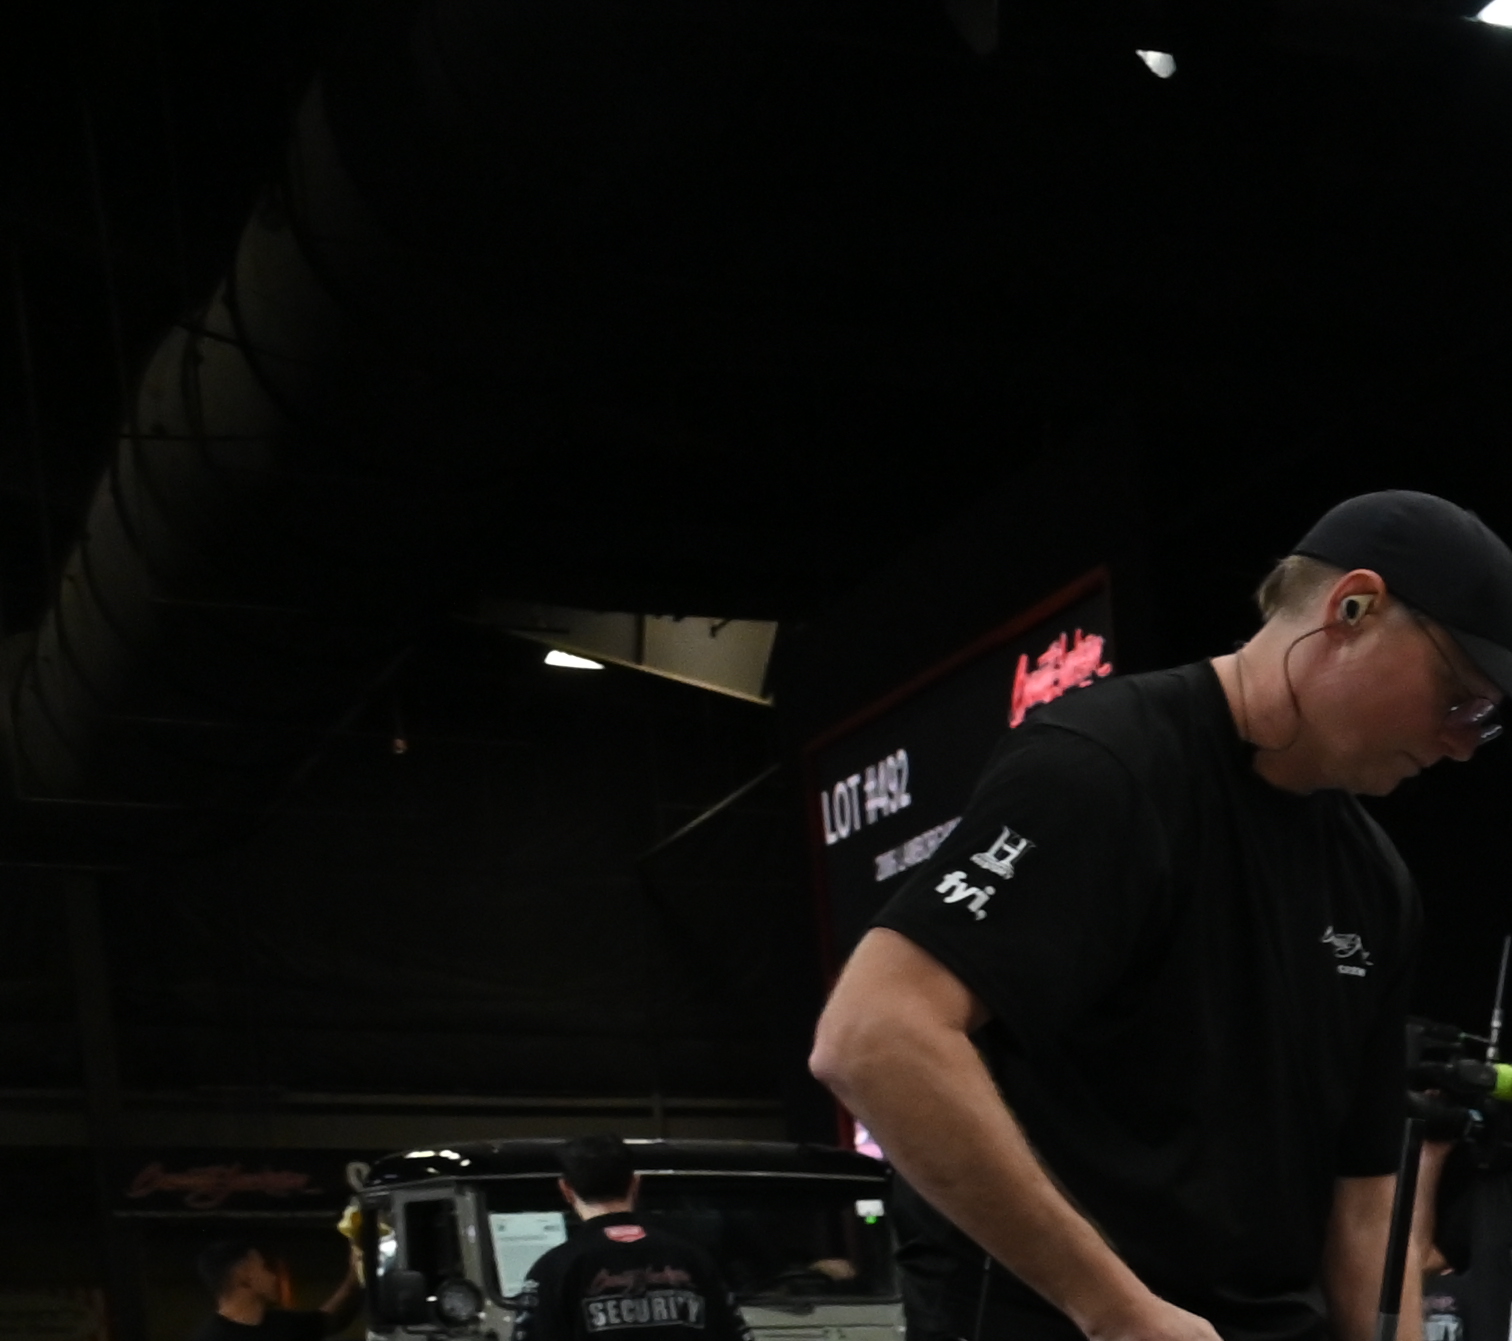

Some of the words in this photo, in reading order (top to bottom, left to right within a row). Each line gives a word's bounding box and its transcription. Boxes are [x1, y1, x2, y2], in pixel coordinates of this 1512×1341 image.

[821, 773, 861, 845] LOT
[863, 748, 911, 825] #492
[935, 871, 996, 921] fyi,
